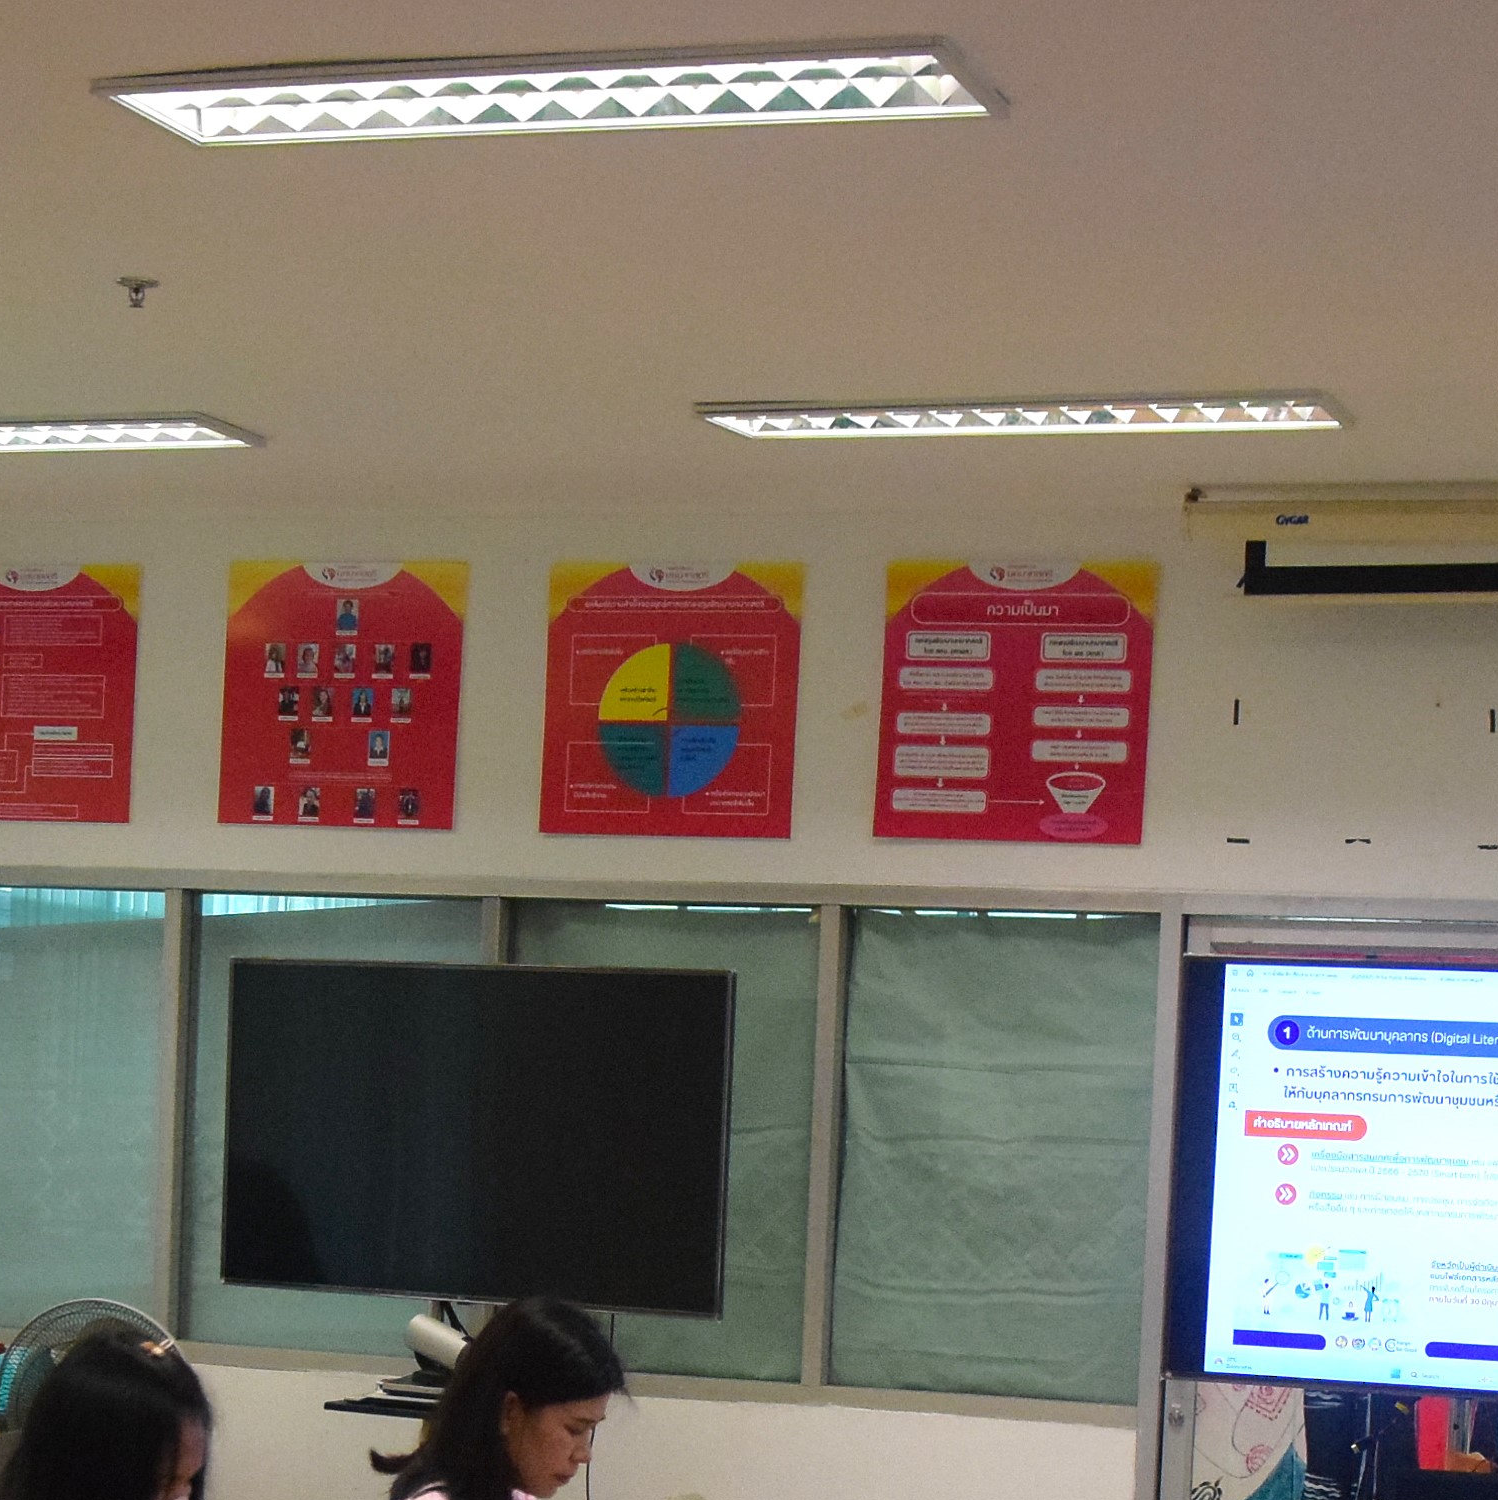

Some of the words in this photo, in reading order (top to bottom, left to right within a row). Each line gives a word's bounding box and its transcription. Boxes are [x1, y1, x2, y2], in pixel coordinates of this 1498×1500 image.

[986, 599, 1059, 617] ความเป็นมา
[1283, 1026, 1292, 1040] 1
[1307, 1026, 1428, 1045] ด้านการพัฒนาบุคลากร
[1431, 1031, 1471, 1046] (Digital
